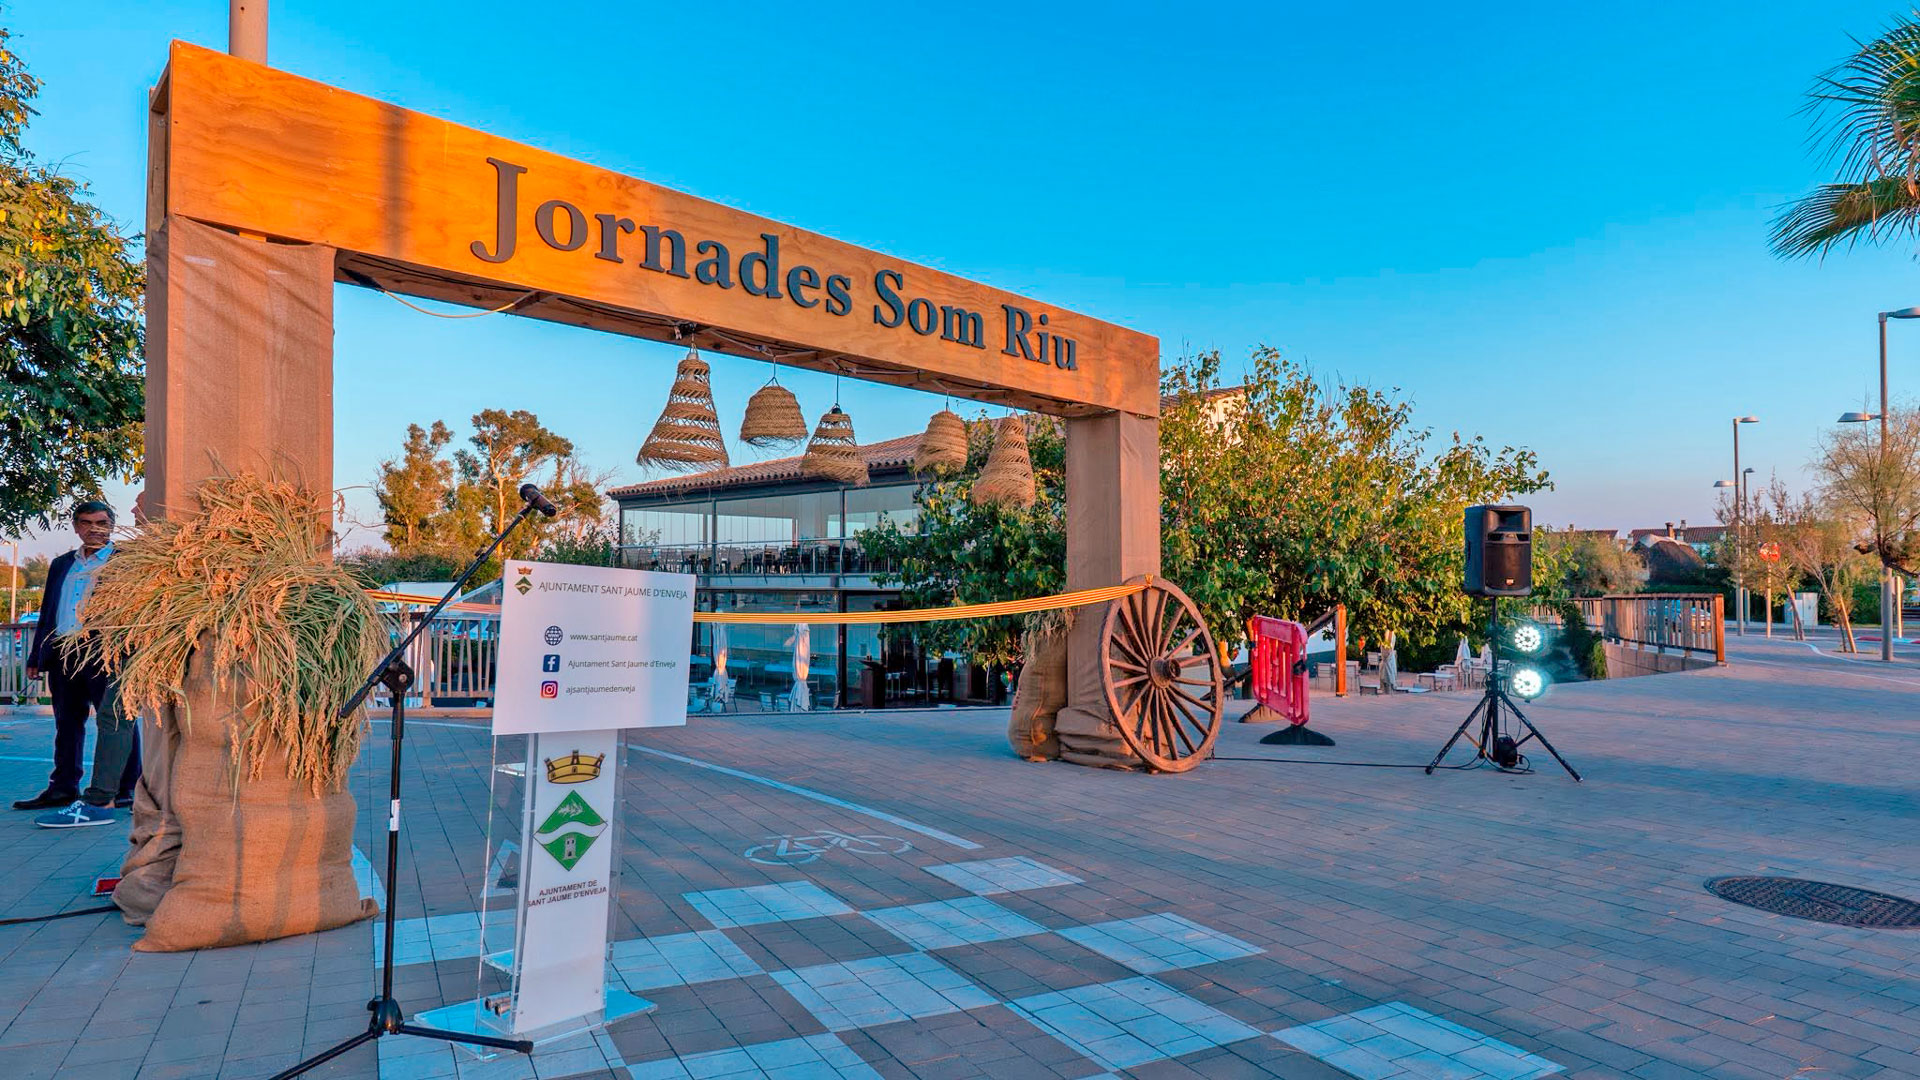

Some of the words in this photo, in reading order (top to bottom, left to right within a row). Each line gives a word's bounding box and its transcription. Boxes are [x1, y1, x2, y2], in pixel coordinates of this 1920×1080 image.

[470, 156, 852, 317] Jornades
[873, 268, 986, 350] Som
[1001, 303, 1079, 371] Riu
[539, 581, 599, 593] AJUNTAMENT
[601, 585, 623, 594] SANT
[624, 587, 652, 597] JAUME
[653, 589, 688, 599] D'ENVEJA
[570, 633, 638, 642] www.santjaume.cat
[568, 660, 610, 669] Ajuntament
[611, 660, 626, 668] Sant
[627, 660, 649, 669] Jaume
[650, 660, 676, 669] d'Enveja
[566, 685, 635, 695] ajsantjaumedenveja
[539, 882, 586, 896] AJUNTAMENT
[527, 898, 545, 908] SANT
[546, 892, 573, 903] JAUME
[573, 887, 607, 898] D'ENVEJA
